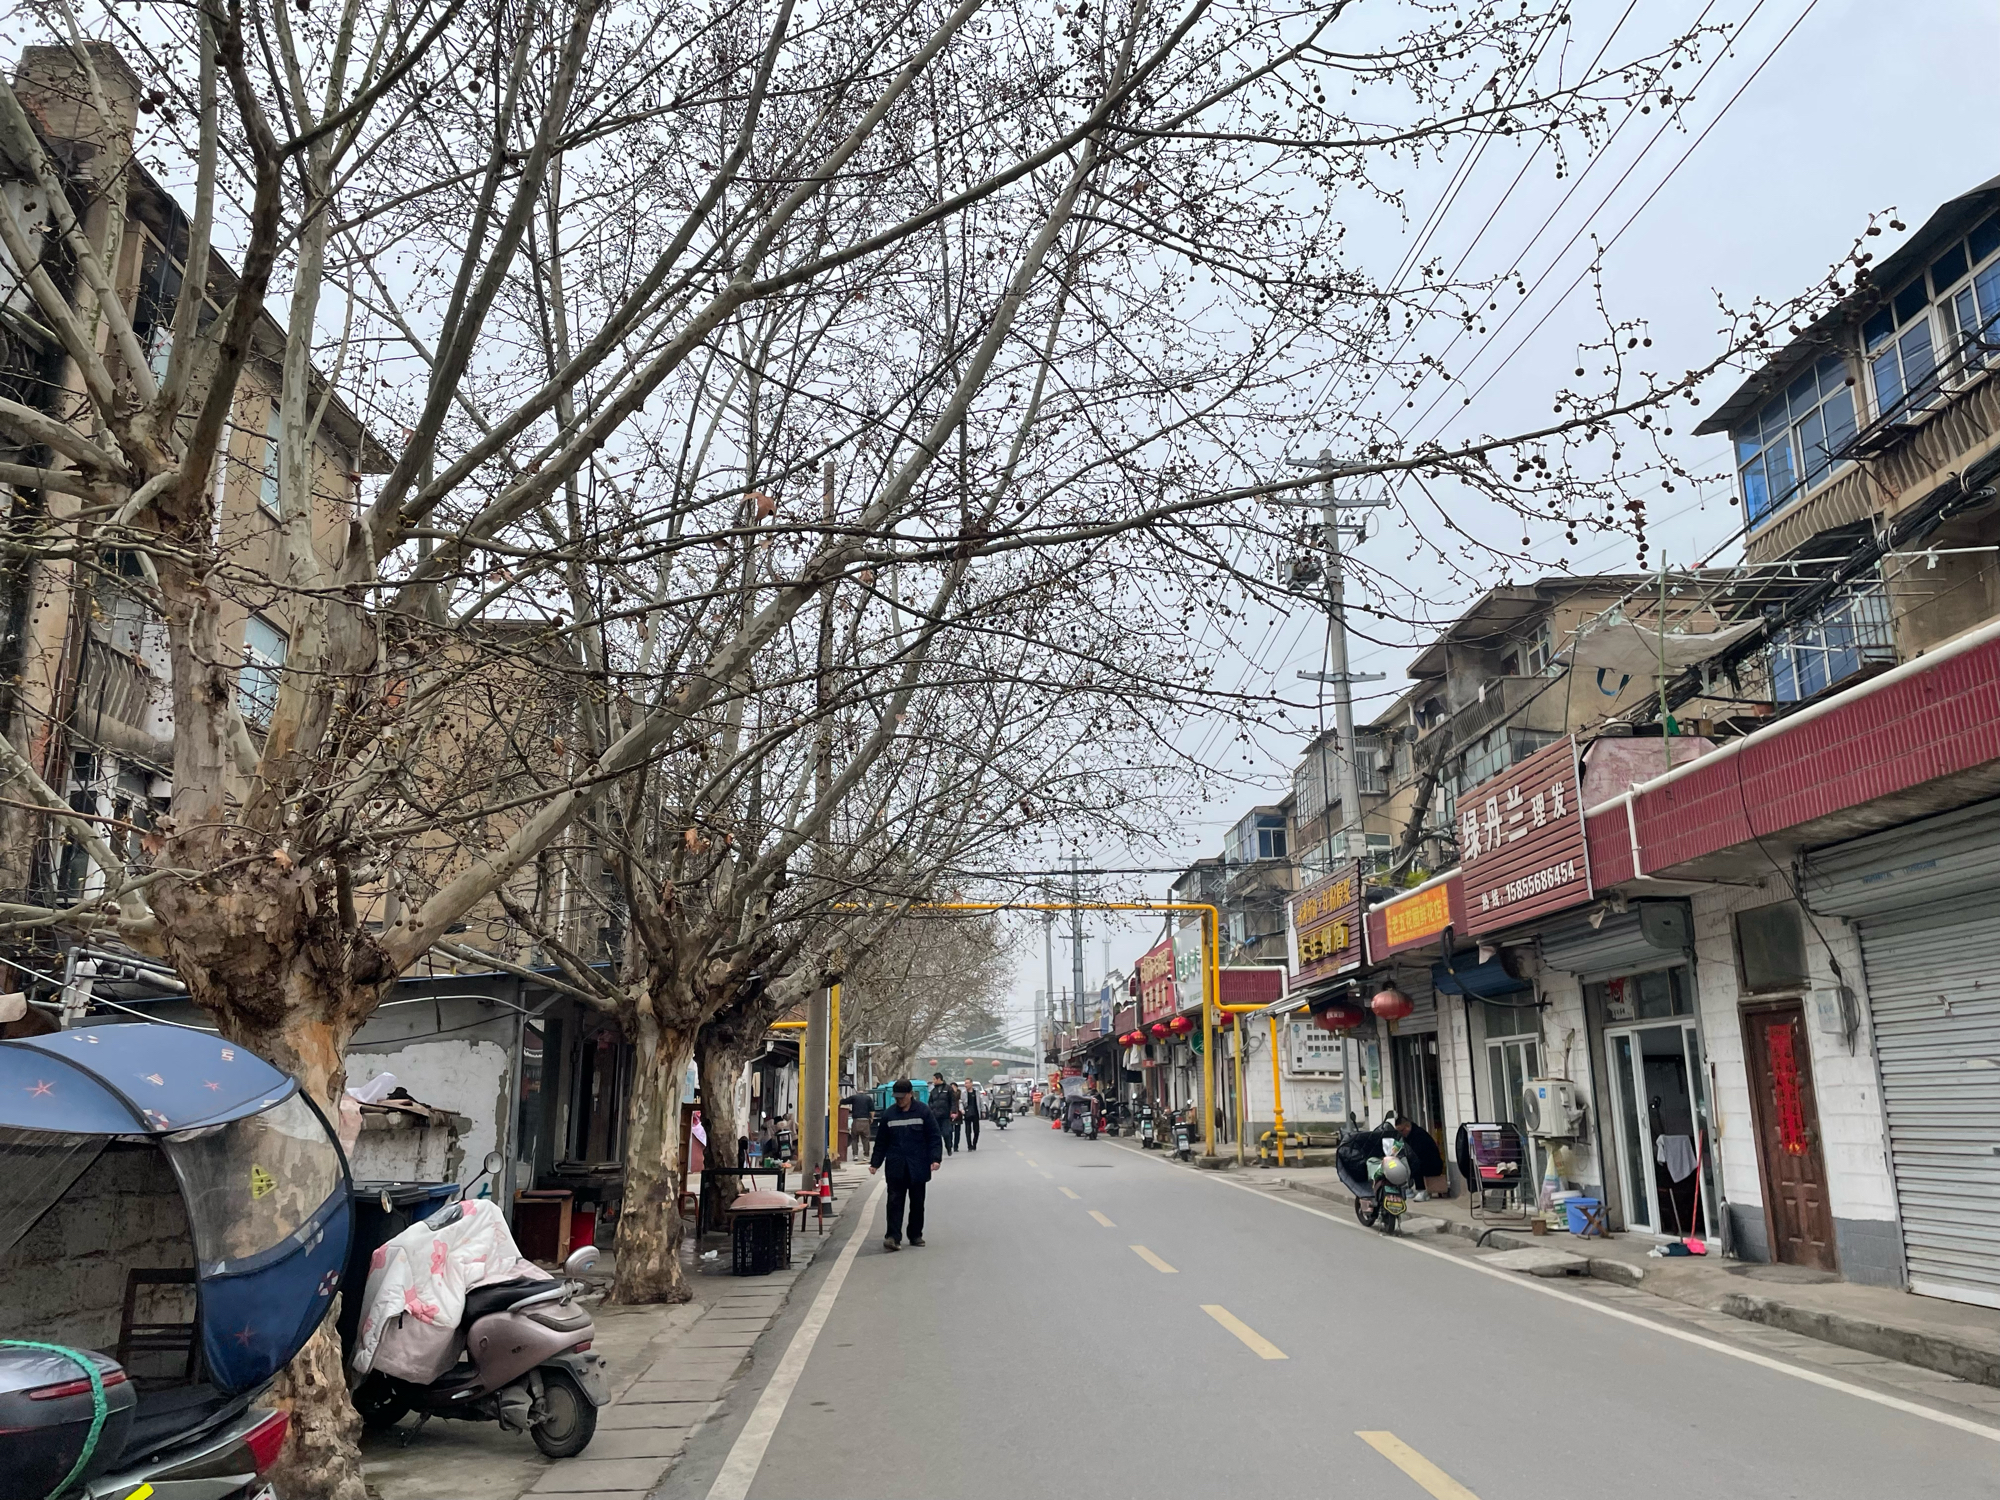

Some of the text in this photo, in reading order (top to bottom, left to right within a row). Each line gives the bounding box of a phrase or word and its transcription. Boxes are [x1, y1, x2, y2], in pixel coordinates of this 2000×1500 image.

[1463, 781, 1568, 860] 绿丹兰理发
